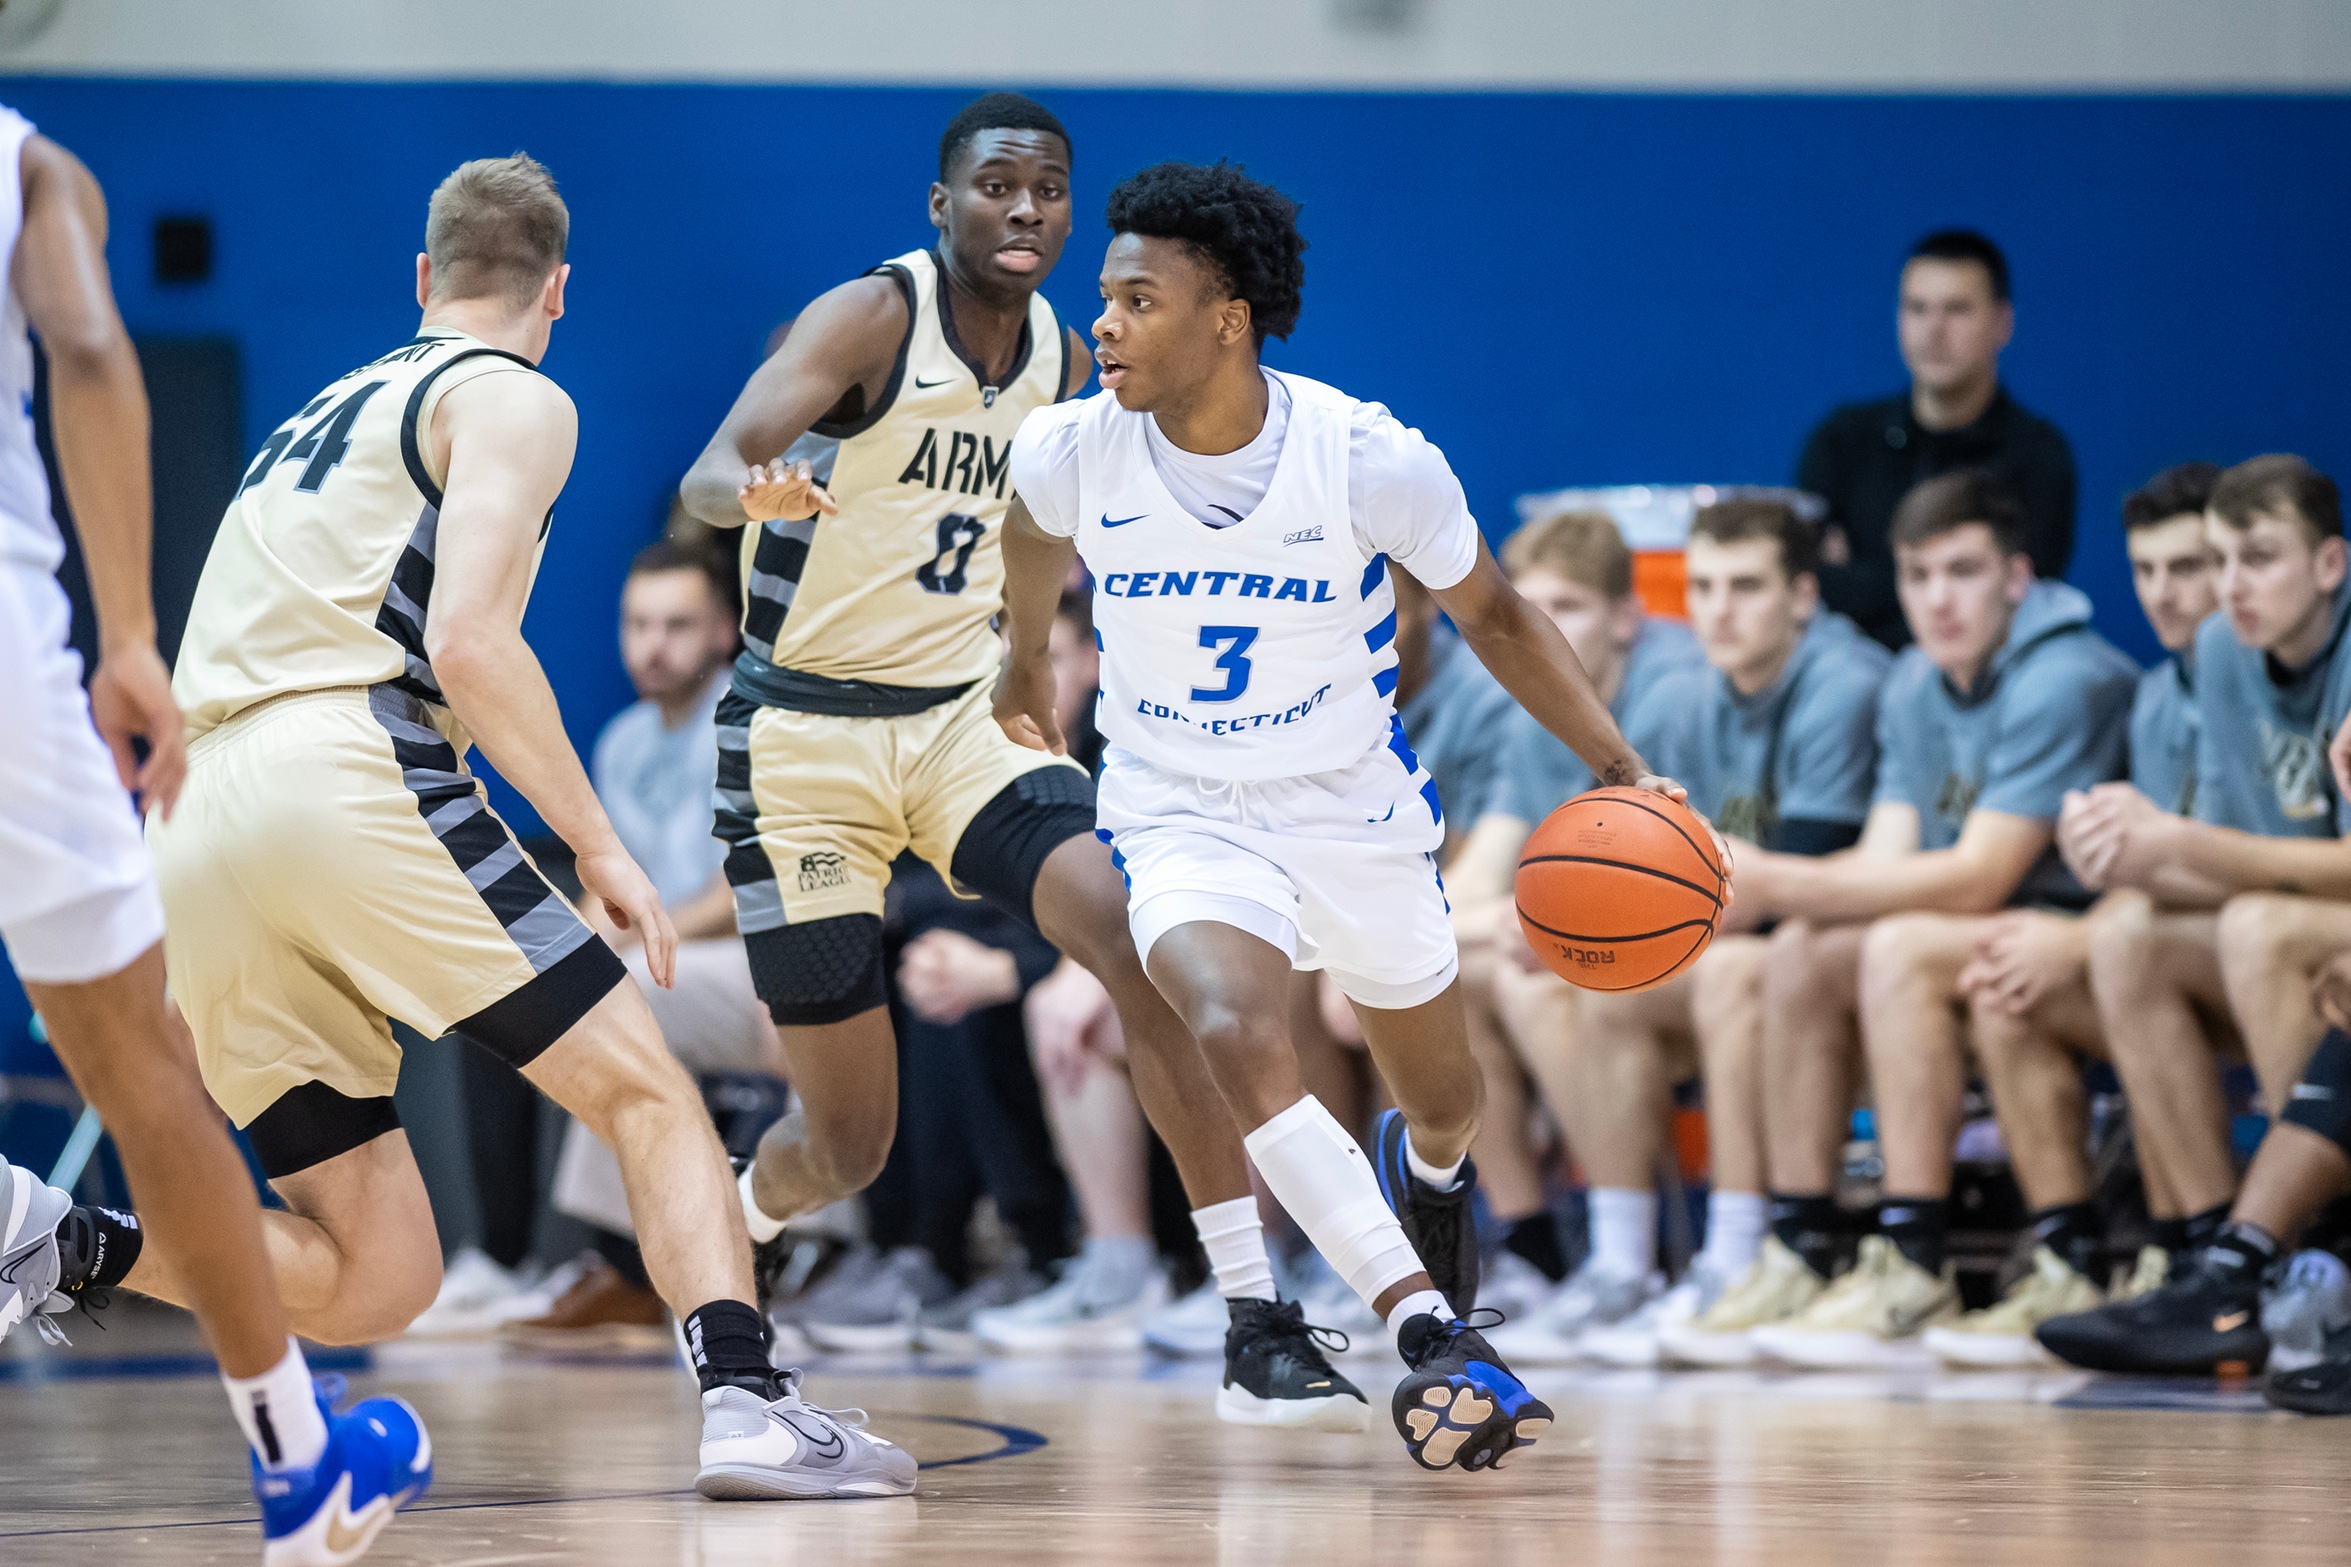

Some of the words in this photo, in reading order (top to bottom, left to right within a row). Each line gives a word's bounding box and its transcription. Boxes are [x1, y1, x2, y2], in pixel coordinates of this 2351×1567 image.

[898, 428, 1019, 501] ARM
[915, 512, 987, 596] 0
[1283, 525, 1323, 544] NEC
[1104, 571, 1338, 603] CENTRAL
[1188, 625, 1261, 705] 3
[1561, 944, 1616, 964] ROCK
